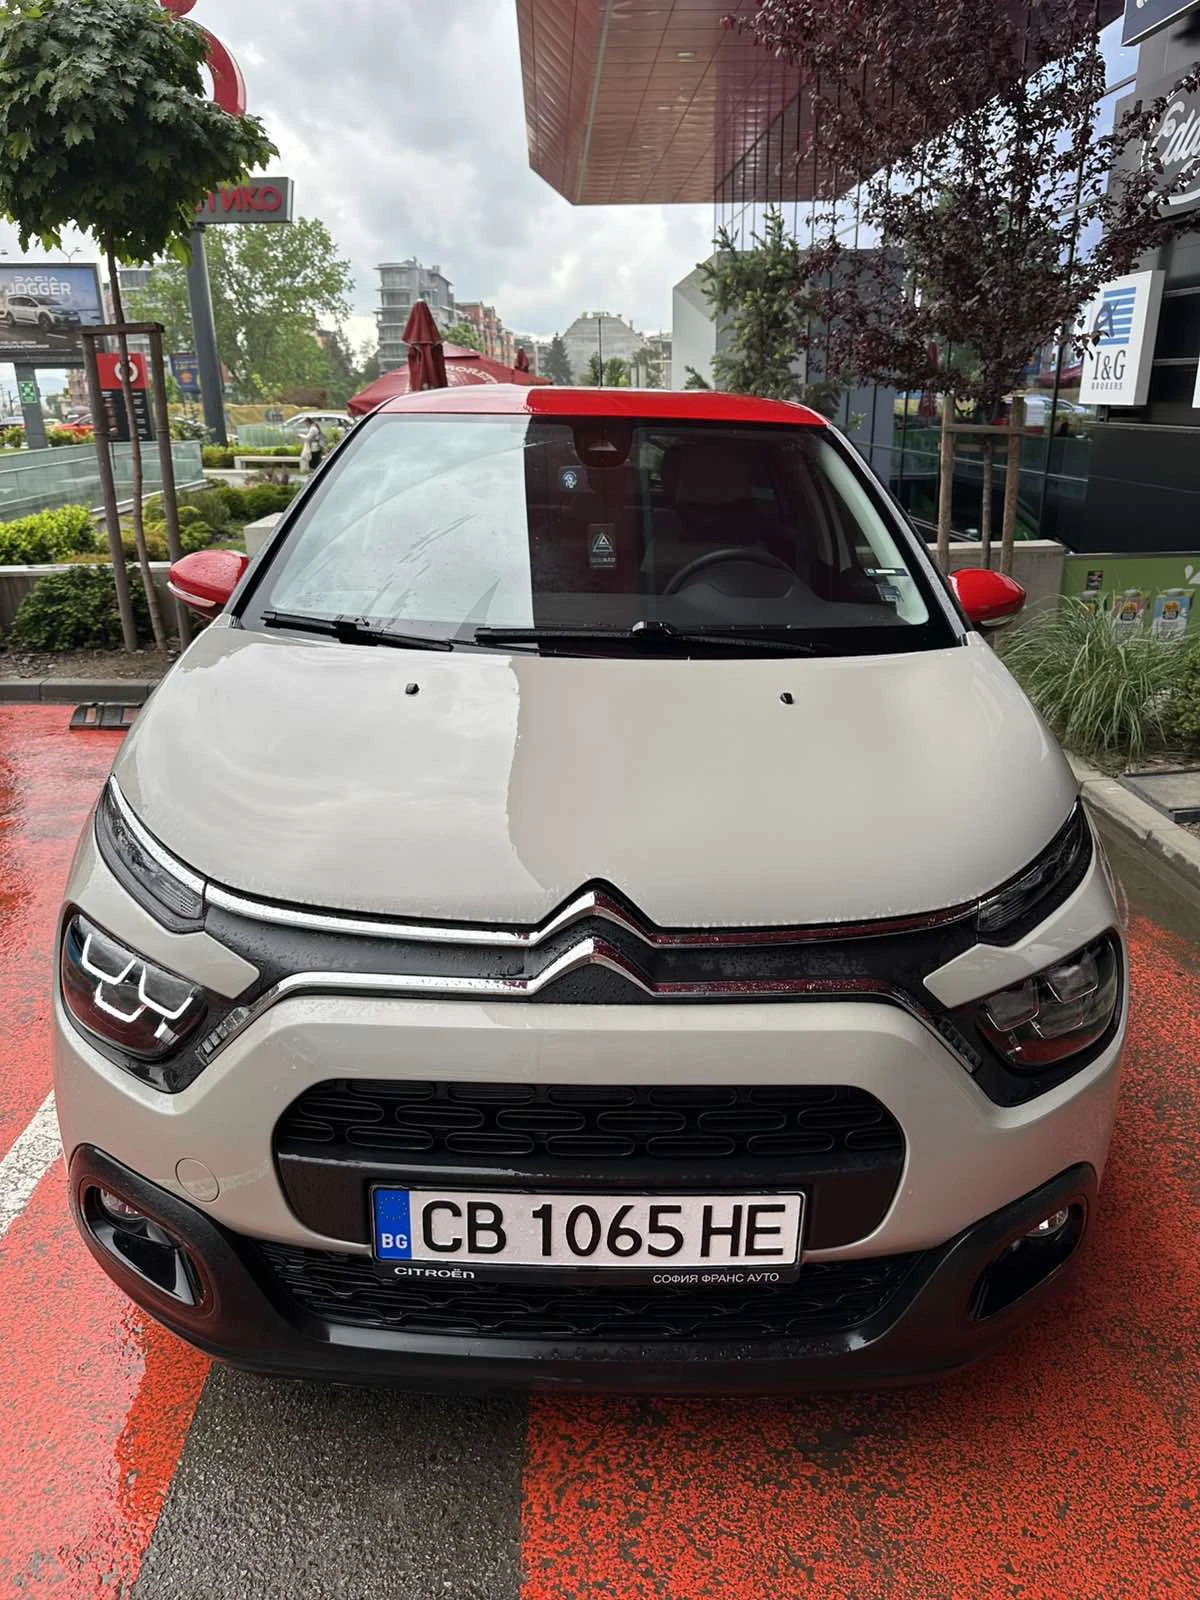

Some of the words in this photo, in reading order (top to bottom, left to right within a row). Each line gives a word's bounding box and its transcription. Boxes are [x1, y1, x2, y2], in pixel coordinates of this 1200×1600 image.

[14, 275, 59, 283] DACIA
[6, 282, 72, 296] JOGGER
[1092, 349, 1127, 381] I&G
[1091, 381, 1123, 391] BROKERS
[422, 1199, 507, 1255] CB
[532, 1203, 684, 1258] 1065
[699, 1203, 786, 1258] HE
[381, 1233, 408, 1249] BG
[652, 1273, 699, 1284] СОФИЯ
[701, 1273, 745, 1283] ФРАНС
[747, 1272, 780, 1283] АУТО
